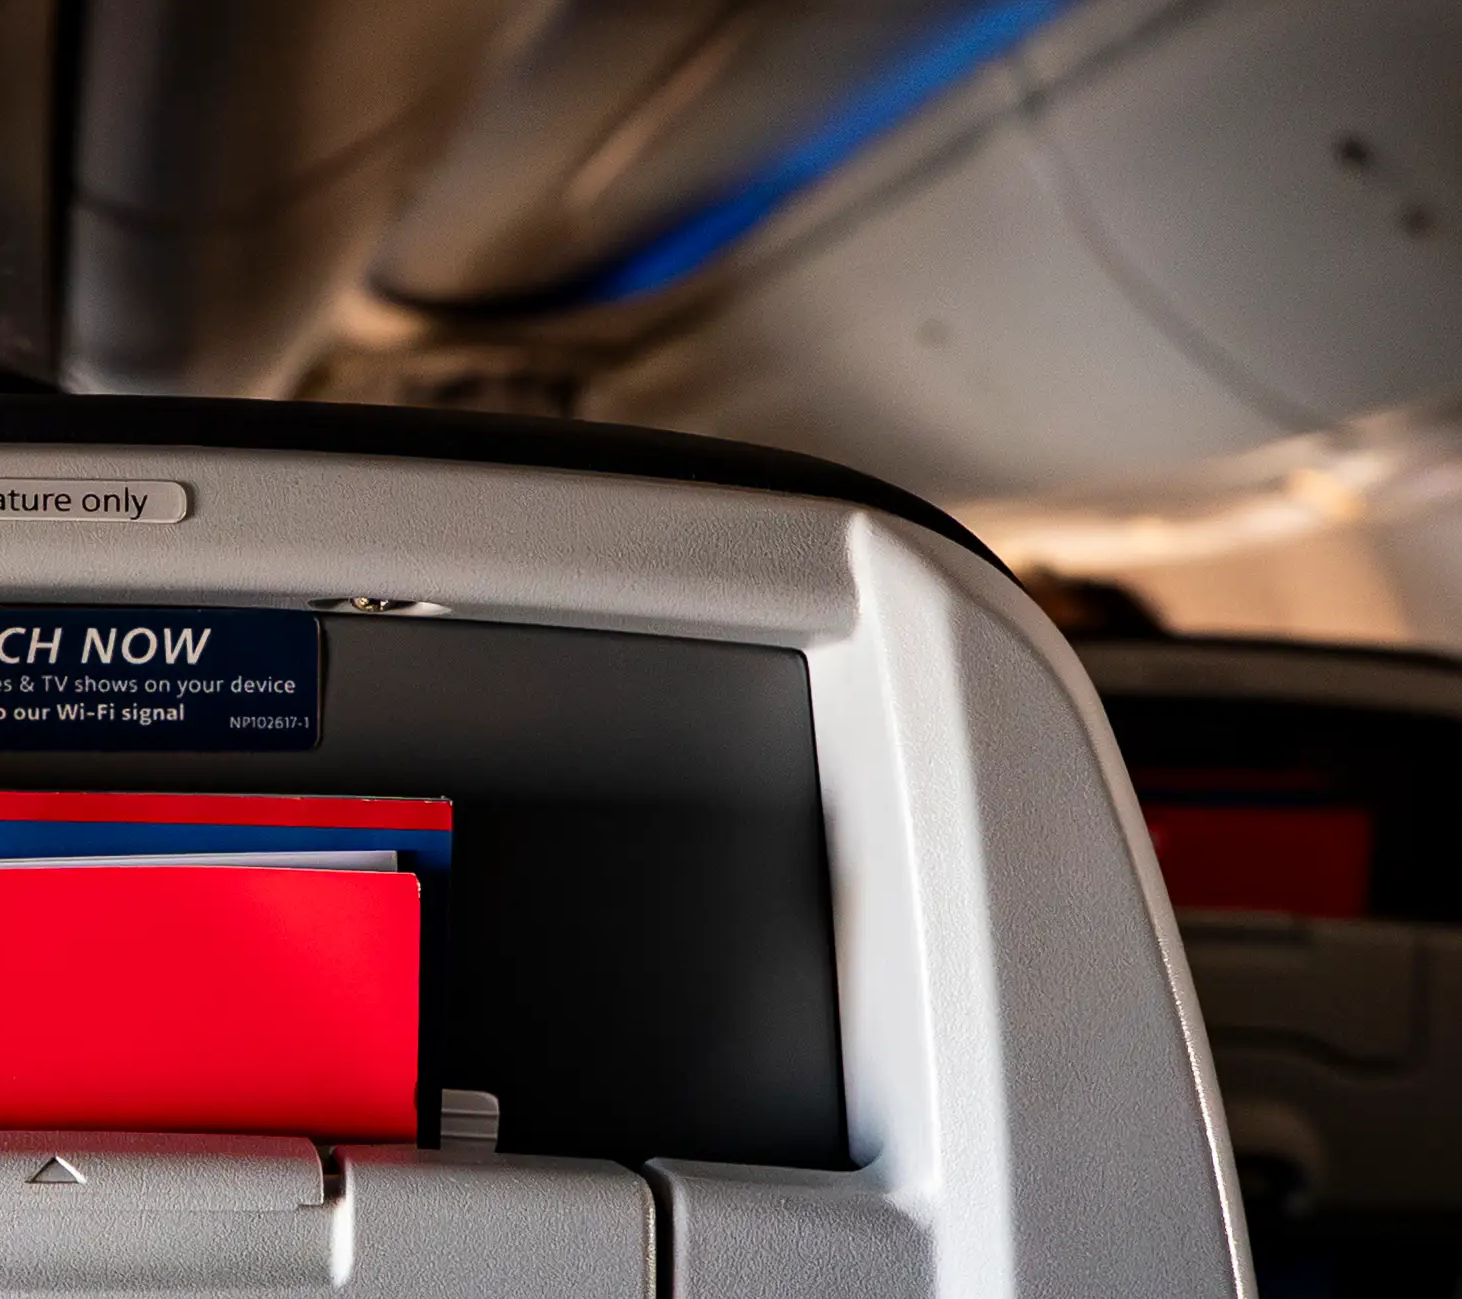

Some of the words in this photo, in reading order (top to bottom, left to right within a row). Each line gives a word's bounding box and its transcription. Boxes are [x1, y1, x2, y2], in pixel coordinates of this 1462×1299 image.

[81, 488, 148, 520] only
[80, 626, 212, 665] NOW
[19, 675, 35, 693] &
[41, 675, 69, 693] TV
[74, 674, 138, 693] shows
[144, 679, 171, 694] on
[176, 678, 224, 699] your
[230, 675, 297, 694] device
[13, 706, 51, 721] our
[56, 702, 115, 722] Wi-Fi
[121, 702, 185, 726] signal
[229, 715, 310, 730] NP102617-1
